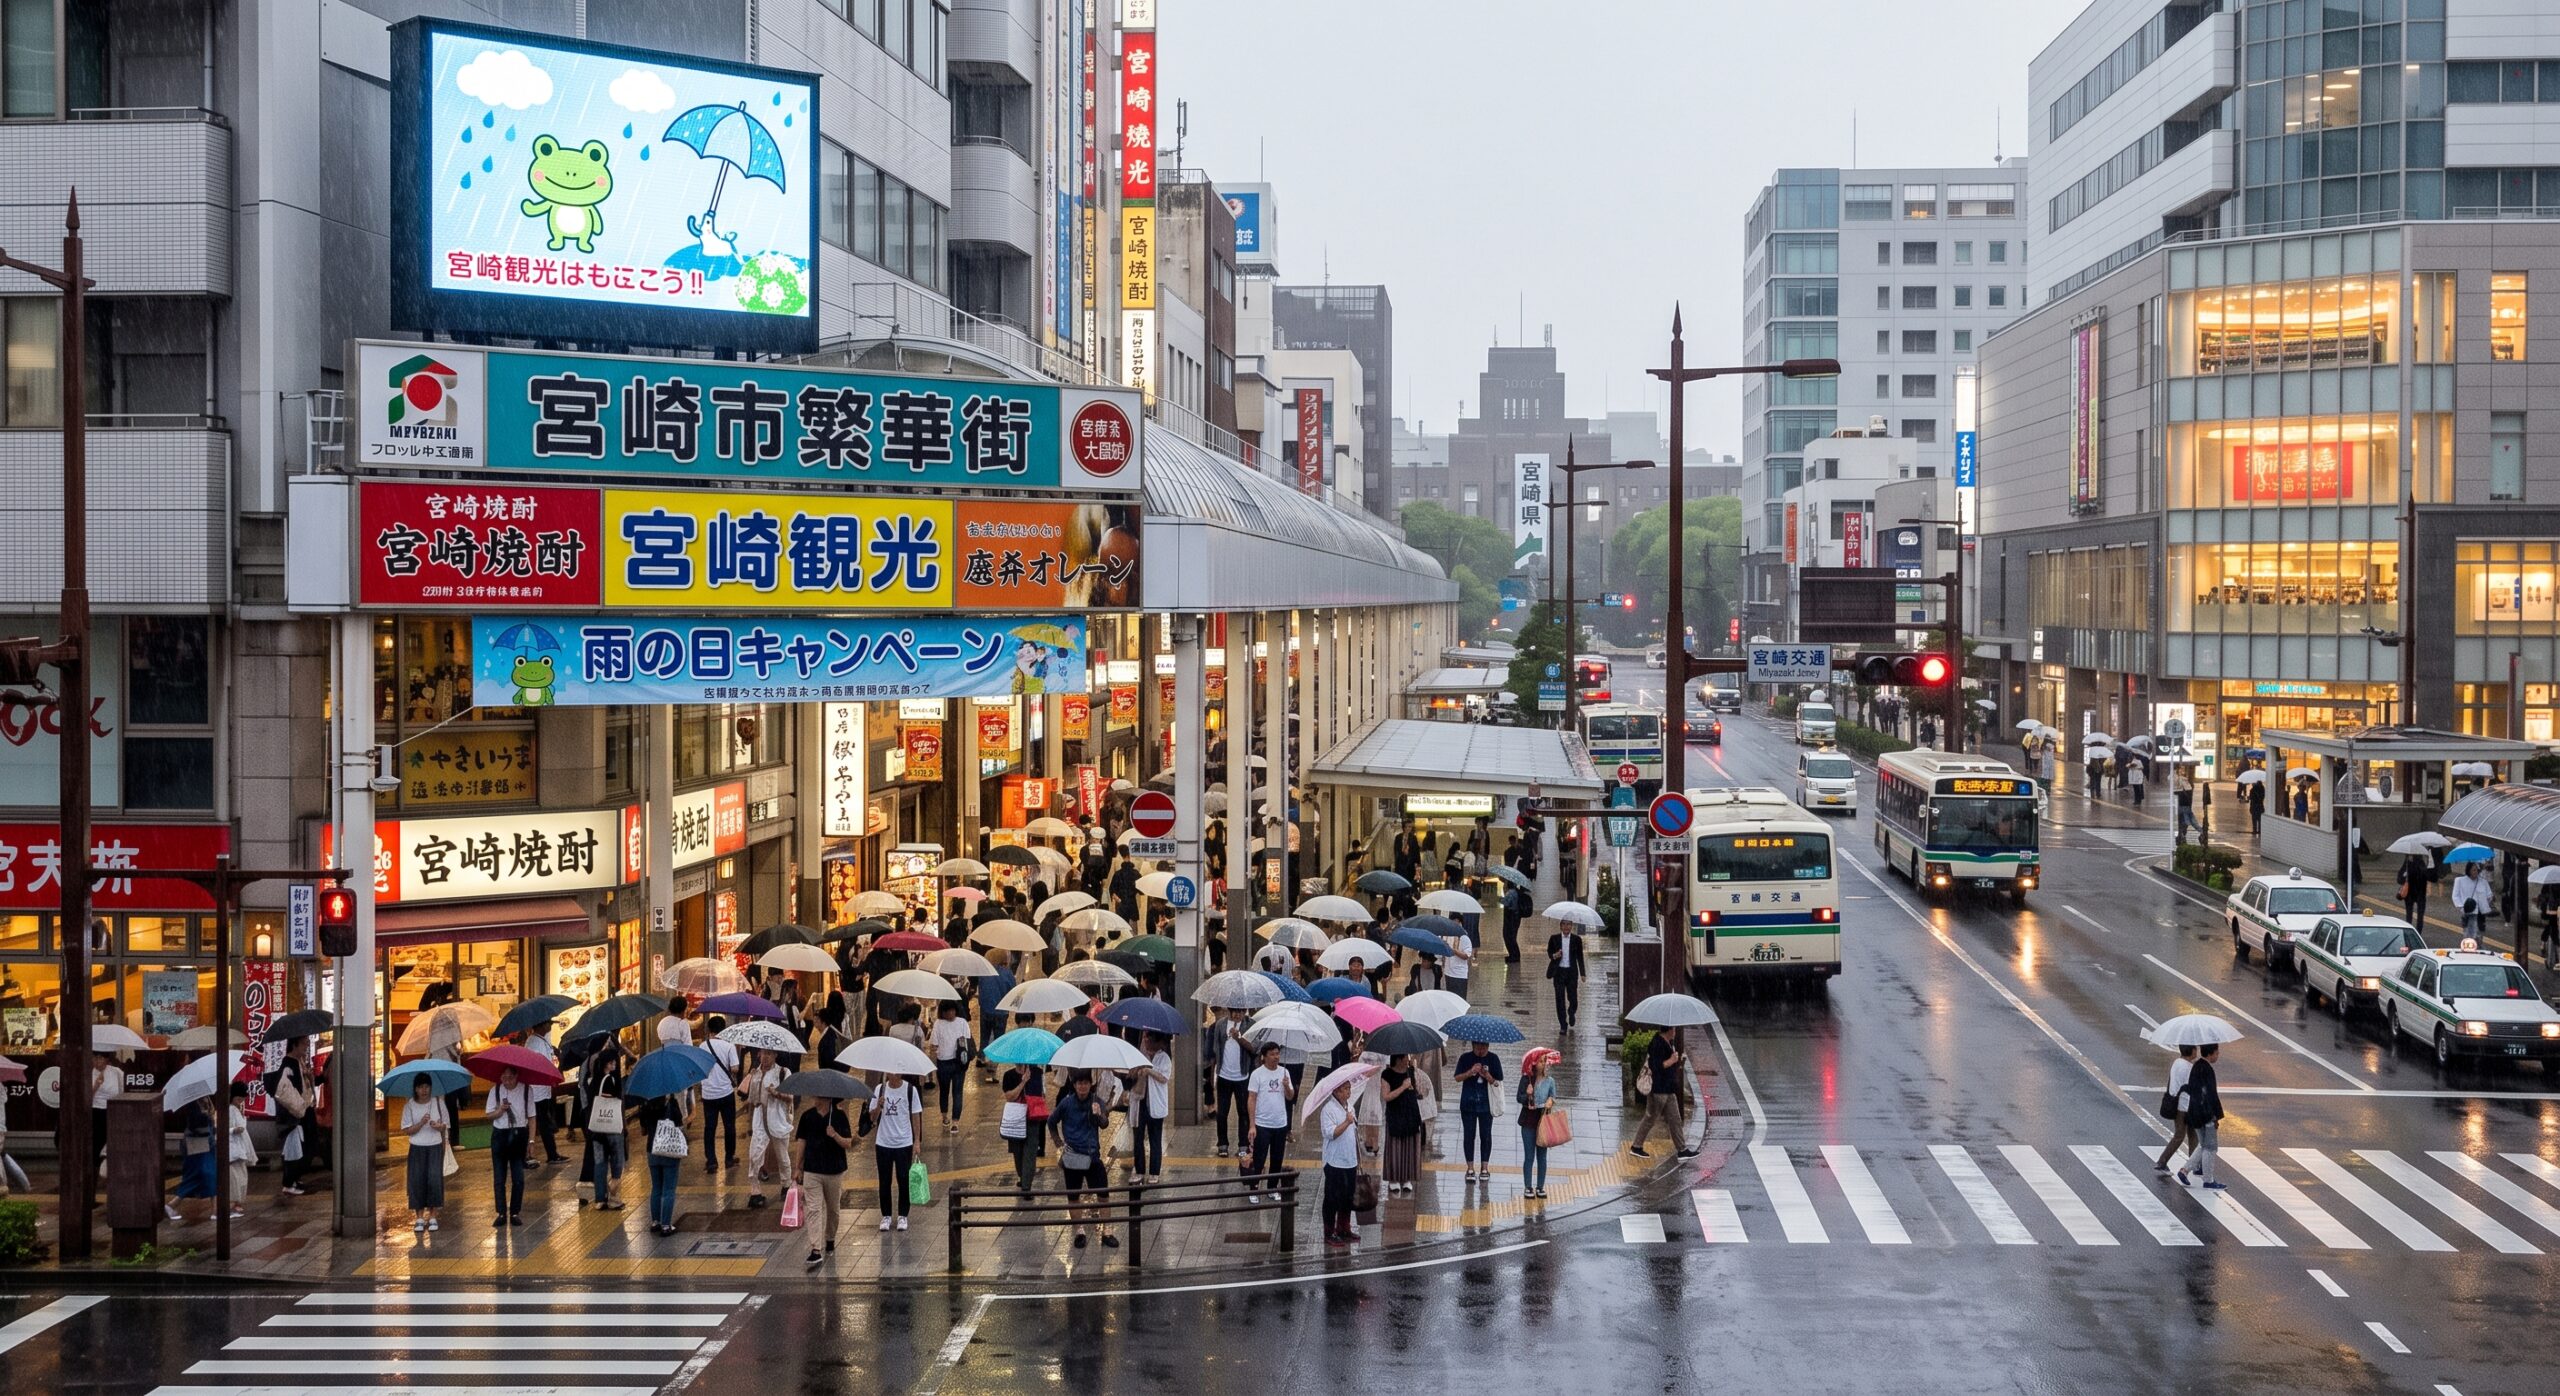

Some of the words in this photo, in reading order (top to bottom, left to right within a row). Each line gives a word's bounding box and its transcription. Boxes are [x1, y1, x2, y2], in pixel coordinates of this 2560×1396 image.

[528, 371, 1032, 474] 宮崎市繁華街
[425, 493, 538, 522] 宮崎焼酎
[1521, 461, 1542, 526] 宮崎県
[377, 522, 586, 579] 宮崎焼酎
[620, 506, 940, 594] 宮崎観光
[580, 624, 1005, 682] 雨の日キャンペーン
[414, 827, 599, 885] 宮崎焼酎
